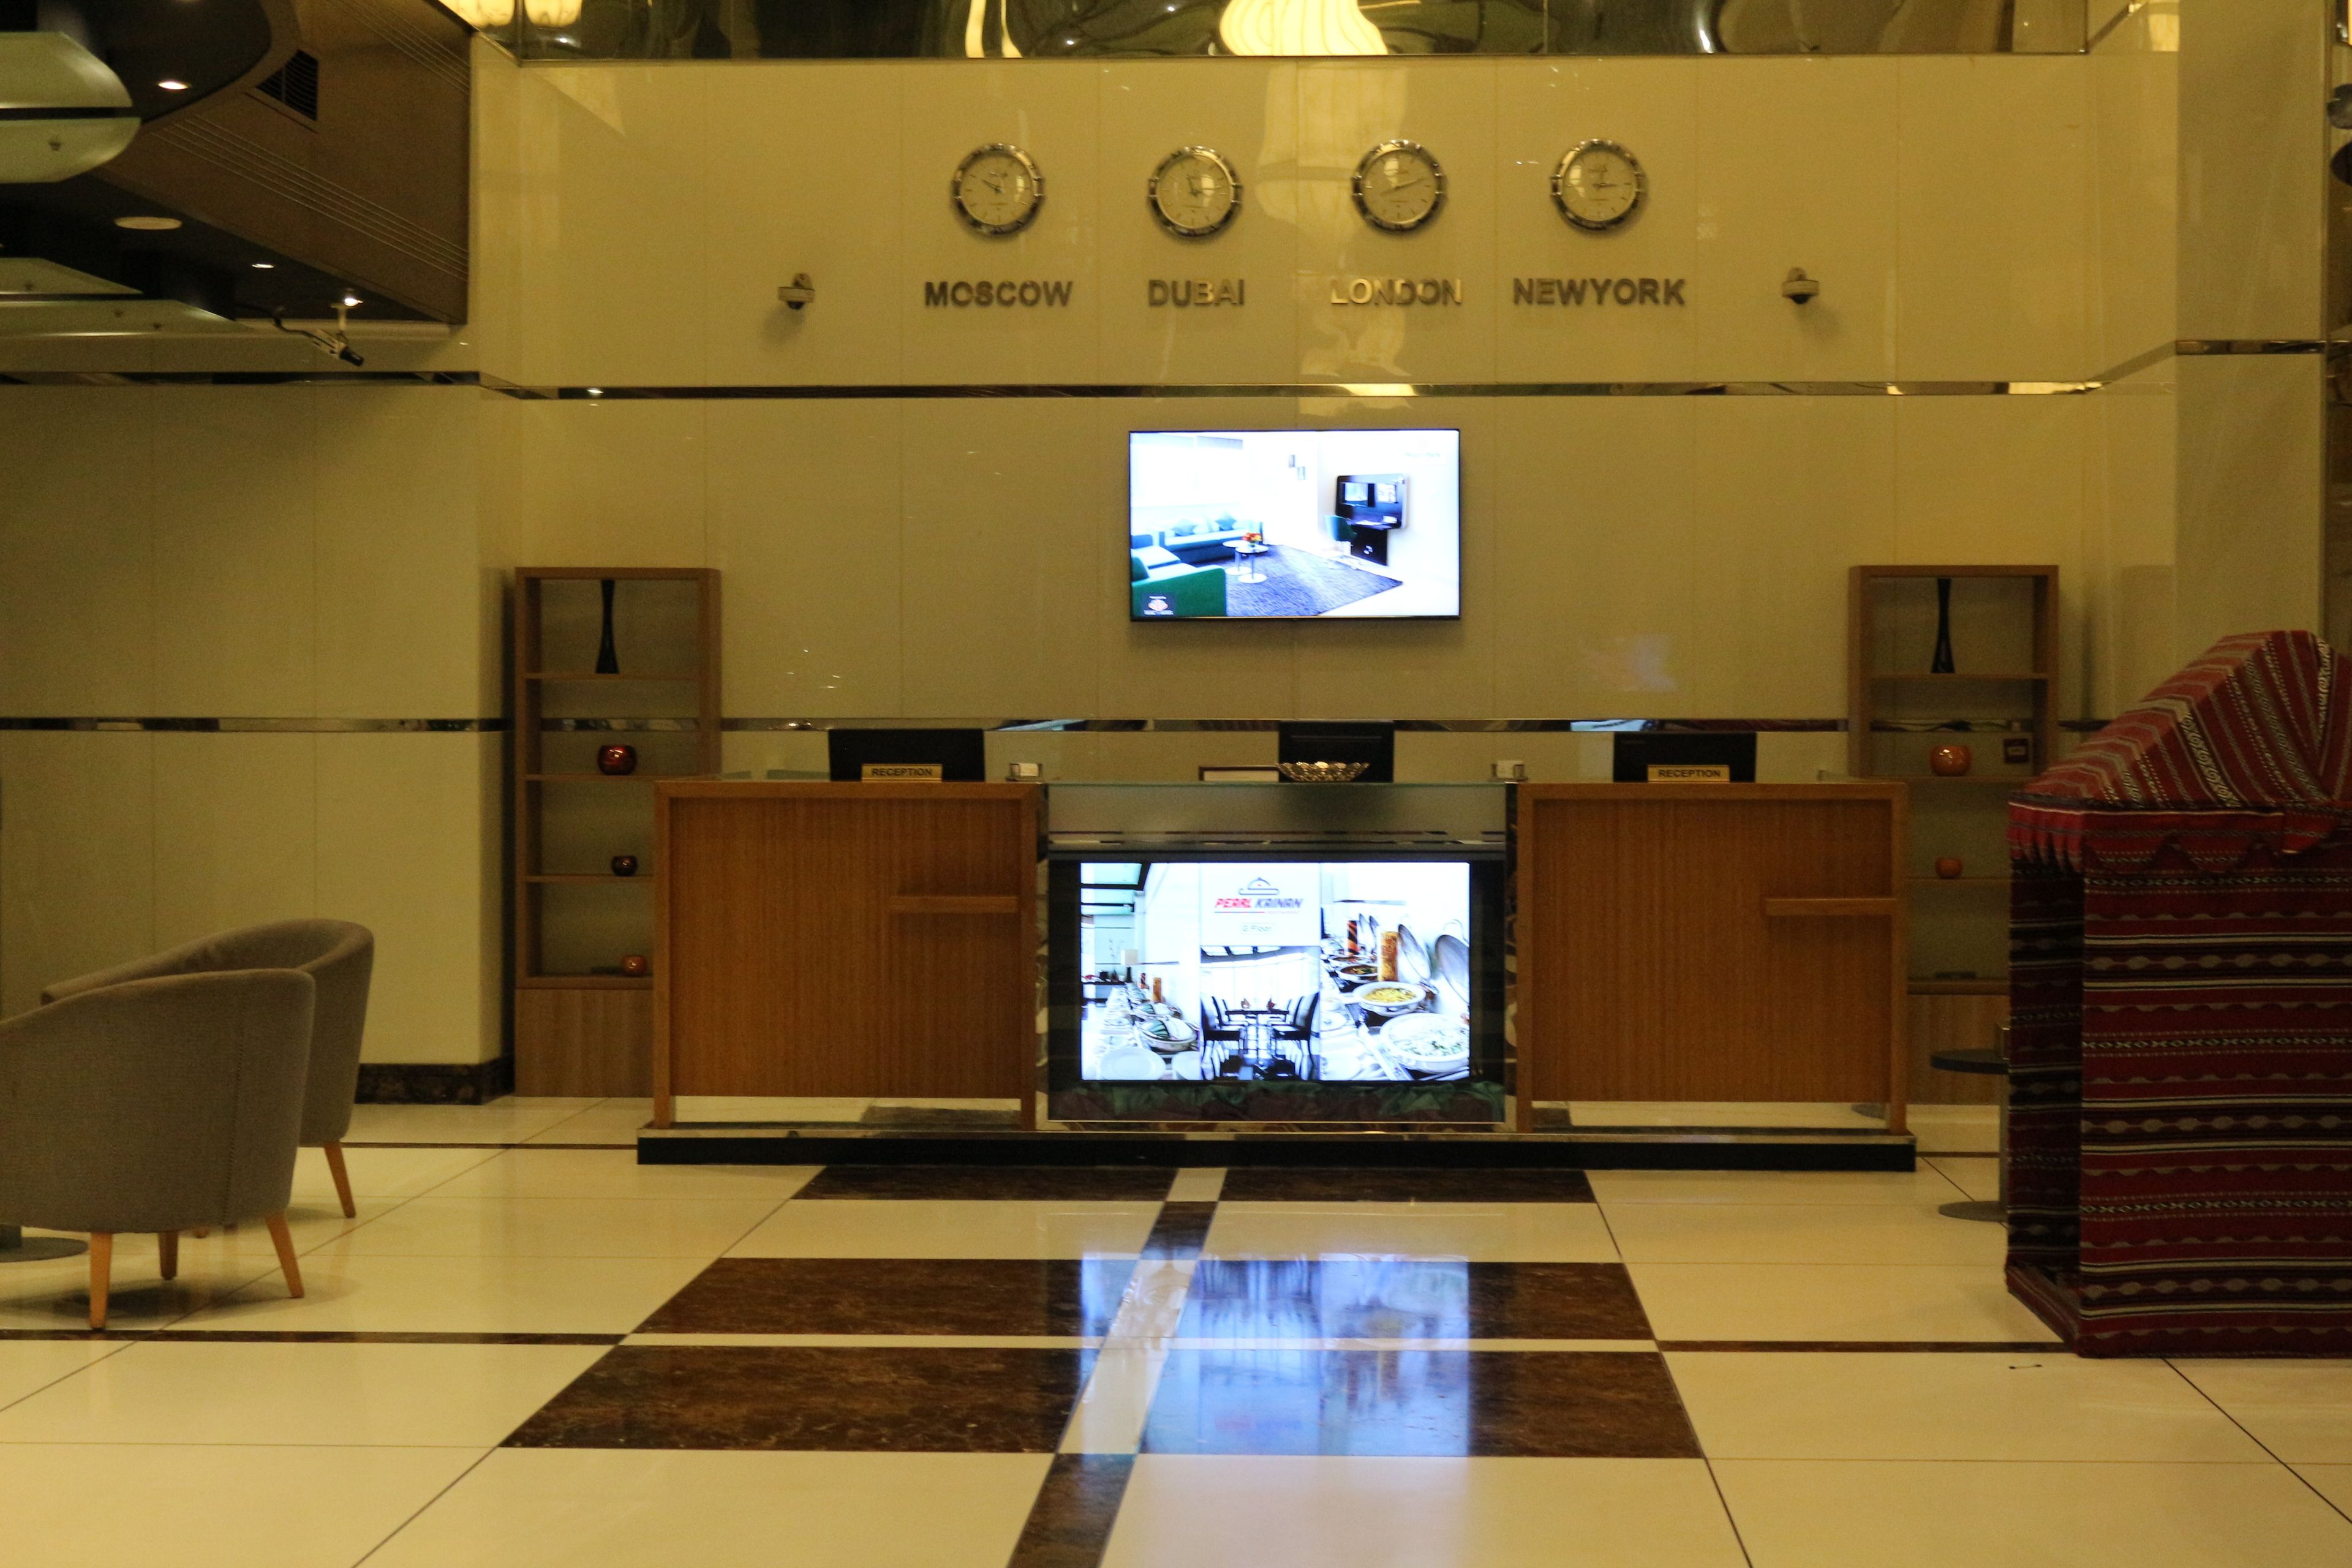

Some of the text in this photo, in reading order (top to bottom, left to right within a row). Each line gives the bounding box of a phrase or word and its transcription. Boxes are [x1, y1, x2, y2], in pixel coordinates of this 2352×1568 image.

[924, 281, 1073, 306] MOSCOW
[1147, 279, 1245, 307] DUBAI
[1330, 277, 1462, 305] LONDON
[1512, 277, 1686, 305] NEWYORK
